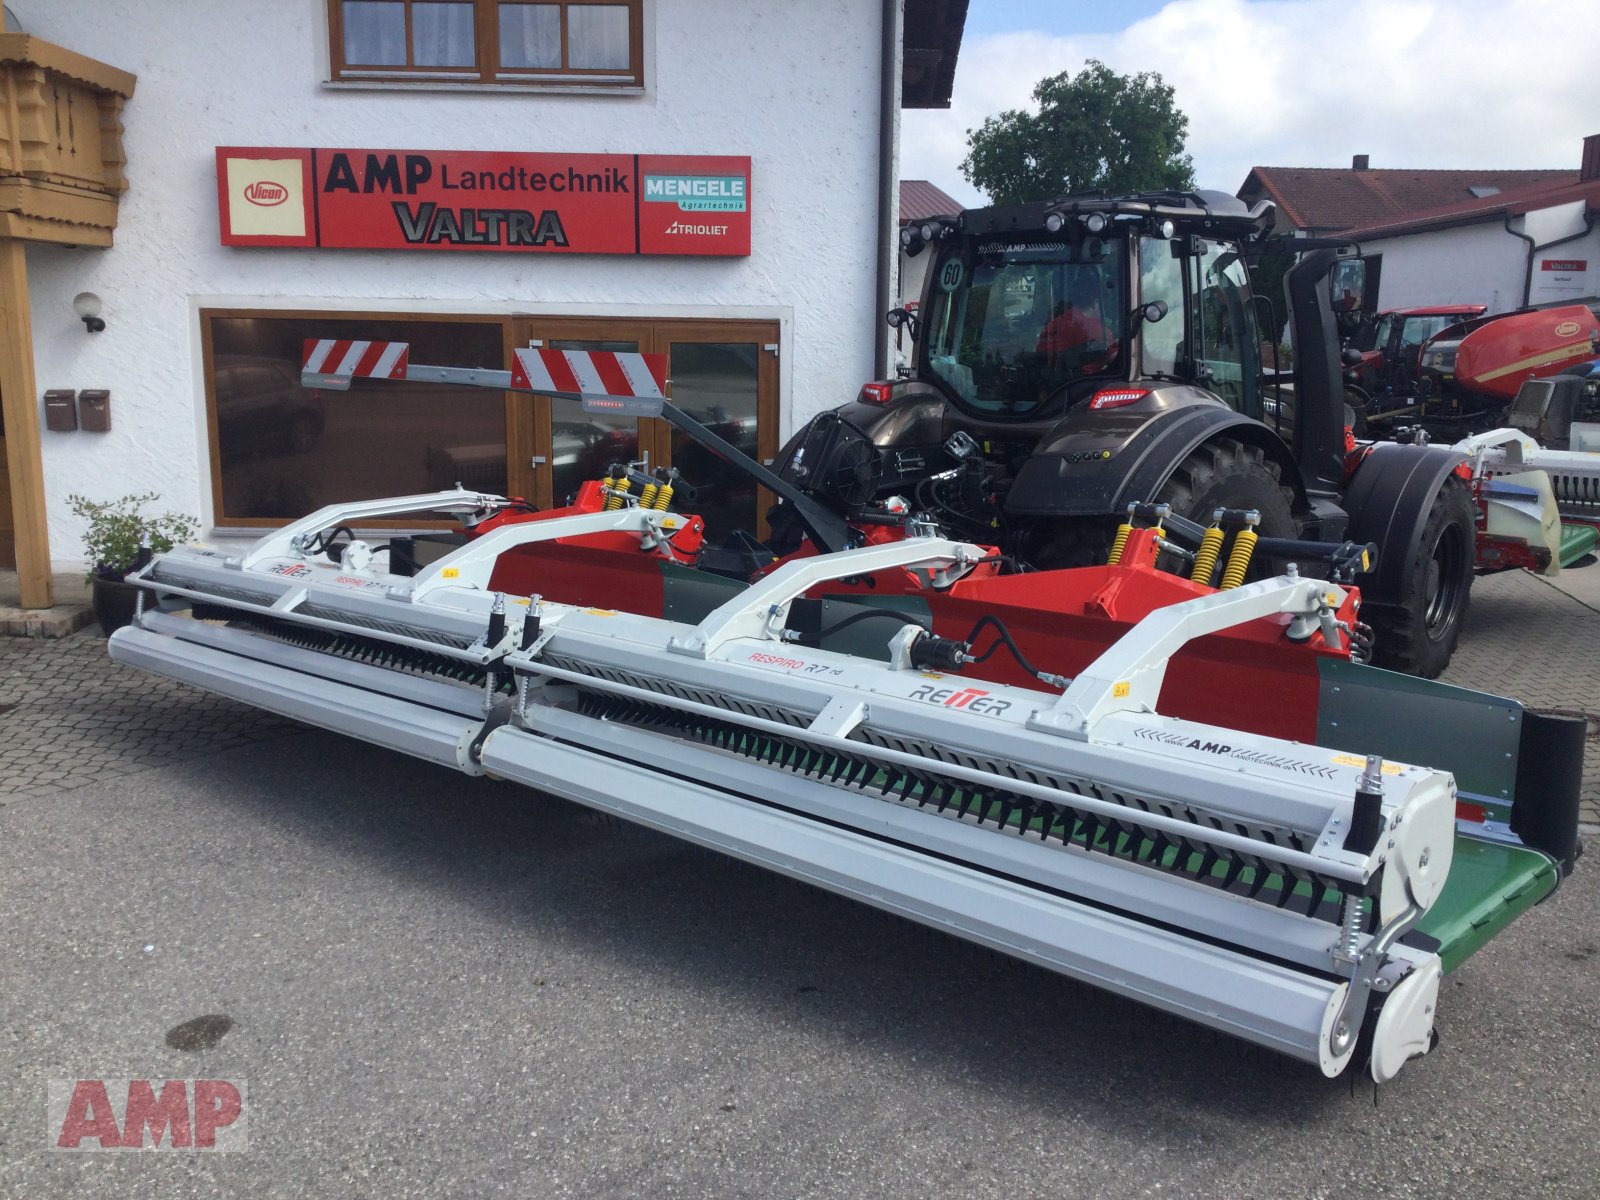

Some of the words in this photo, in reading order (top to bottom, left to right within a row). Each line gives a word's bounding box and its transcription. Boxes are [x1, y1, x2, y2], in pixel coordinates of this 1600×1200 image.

[324, 153, 432, 195] AMP
[441, 164, 629, 193] Landtechnik
[247, 182, 284, 201] Vicon
[646, 179, 743, 197] MENGELE
[681, 201, 743, 210] Agrartechnik
[391, 201, 570, 247] VALTRA
[677, 224, 728, 235] TRIOLIET
[1006, 244, 1026, 253] AMP
[943, 263, 960, 286] 60
[748, 652, 804, 669] RESPIRO
[804, 663, 830, 674] R7
[908, 685, 1012, 716] REITER
